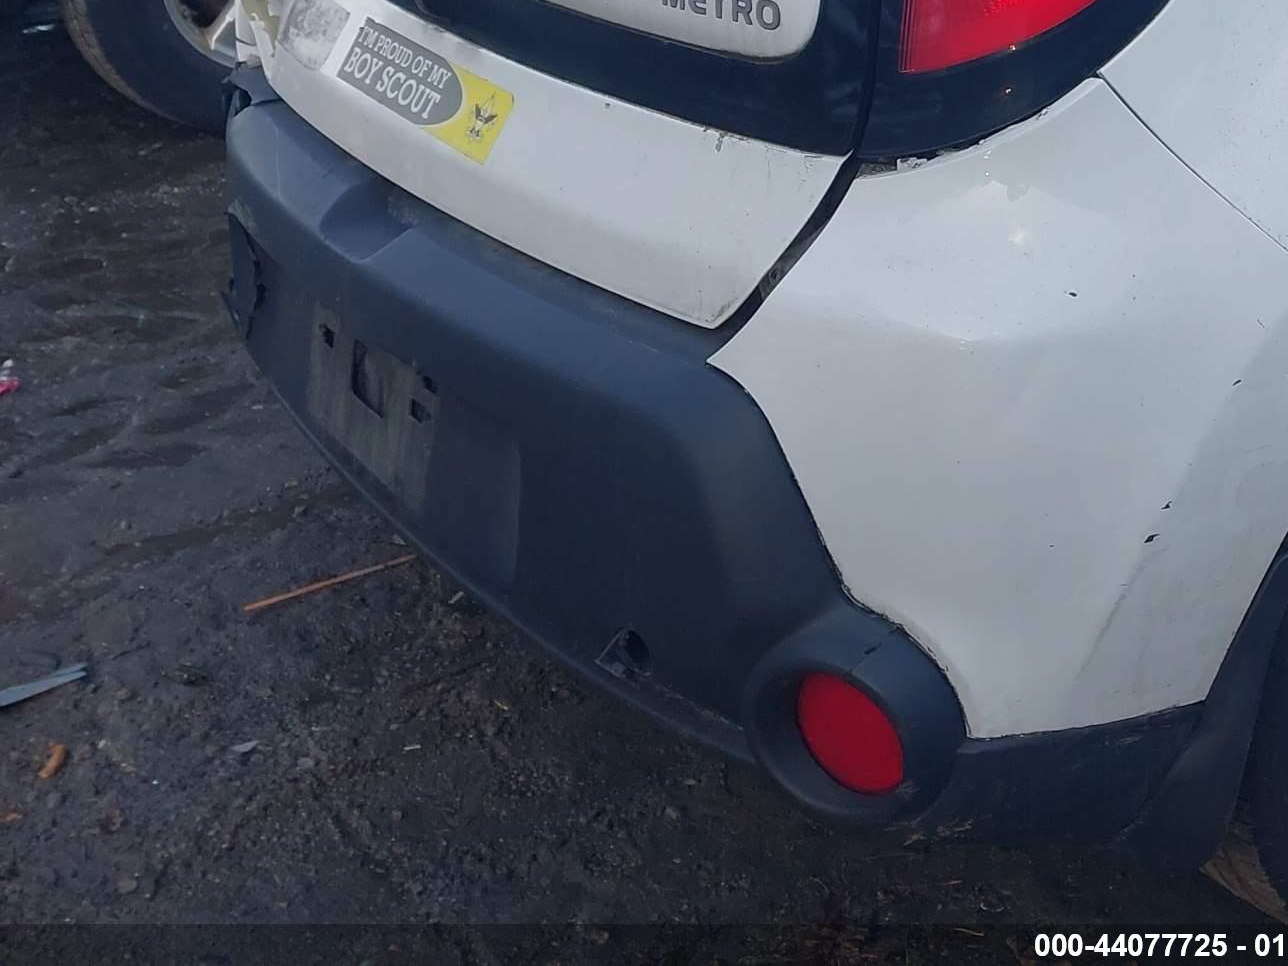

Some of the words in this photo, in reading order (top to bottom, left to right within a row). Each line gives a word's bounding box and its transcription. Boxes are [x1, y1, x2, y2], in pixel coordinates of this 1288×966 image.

[344, 46, 382, 85] BOY
[375, 65, 442, 120] SCOUT
[358, 25, 377, 50] I'M
[374, 35, 413, 67] PROUD
[411, 55, 434, 78] OF
[426, 64, 452, 90] MY
